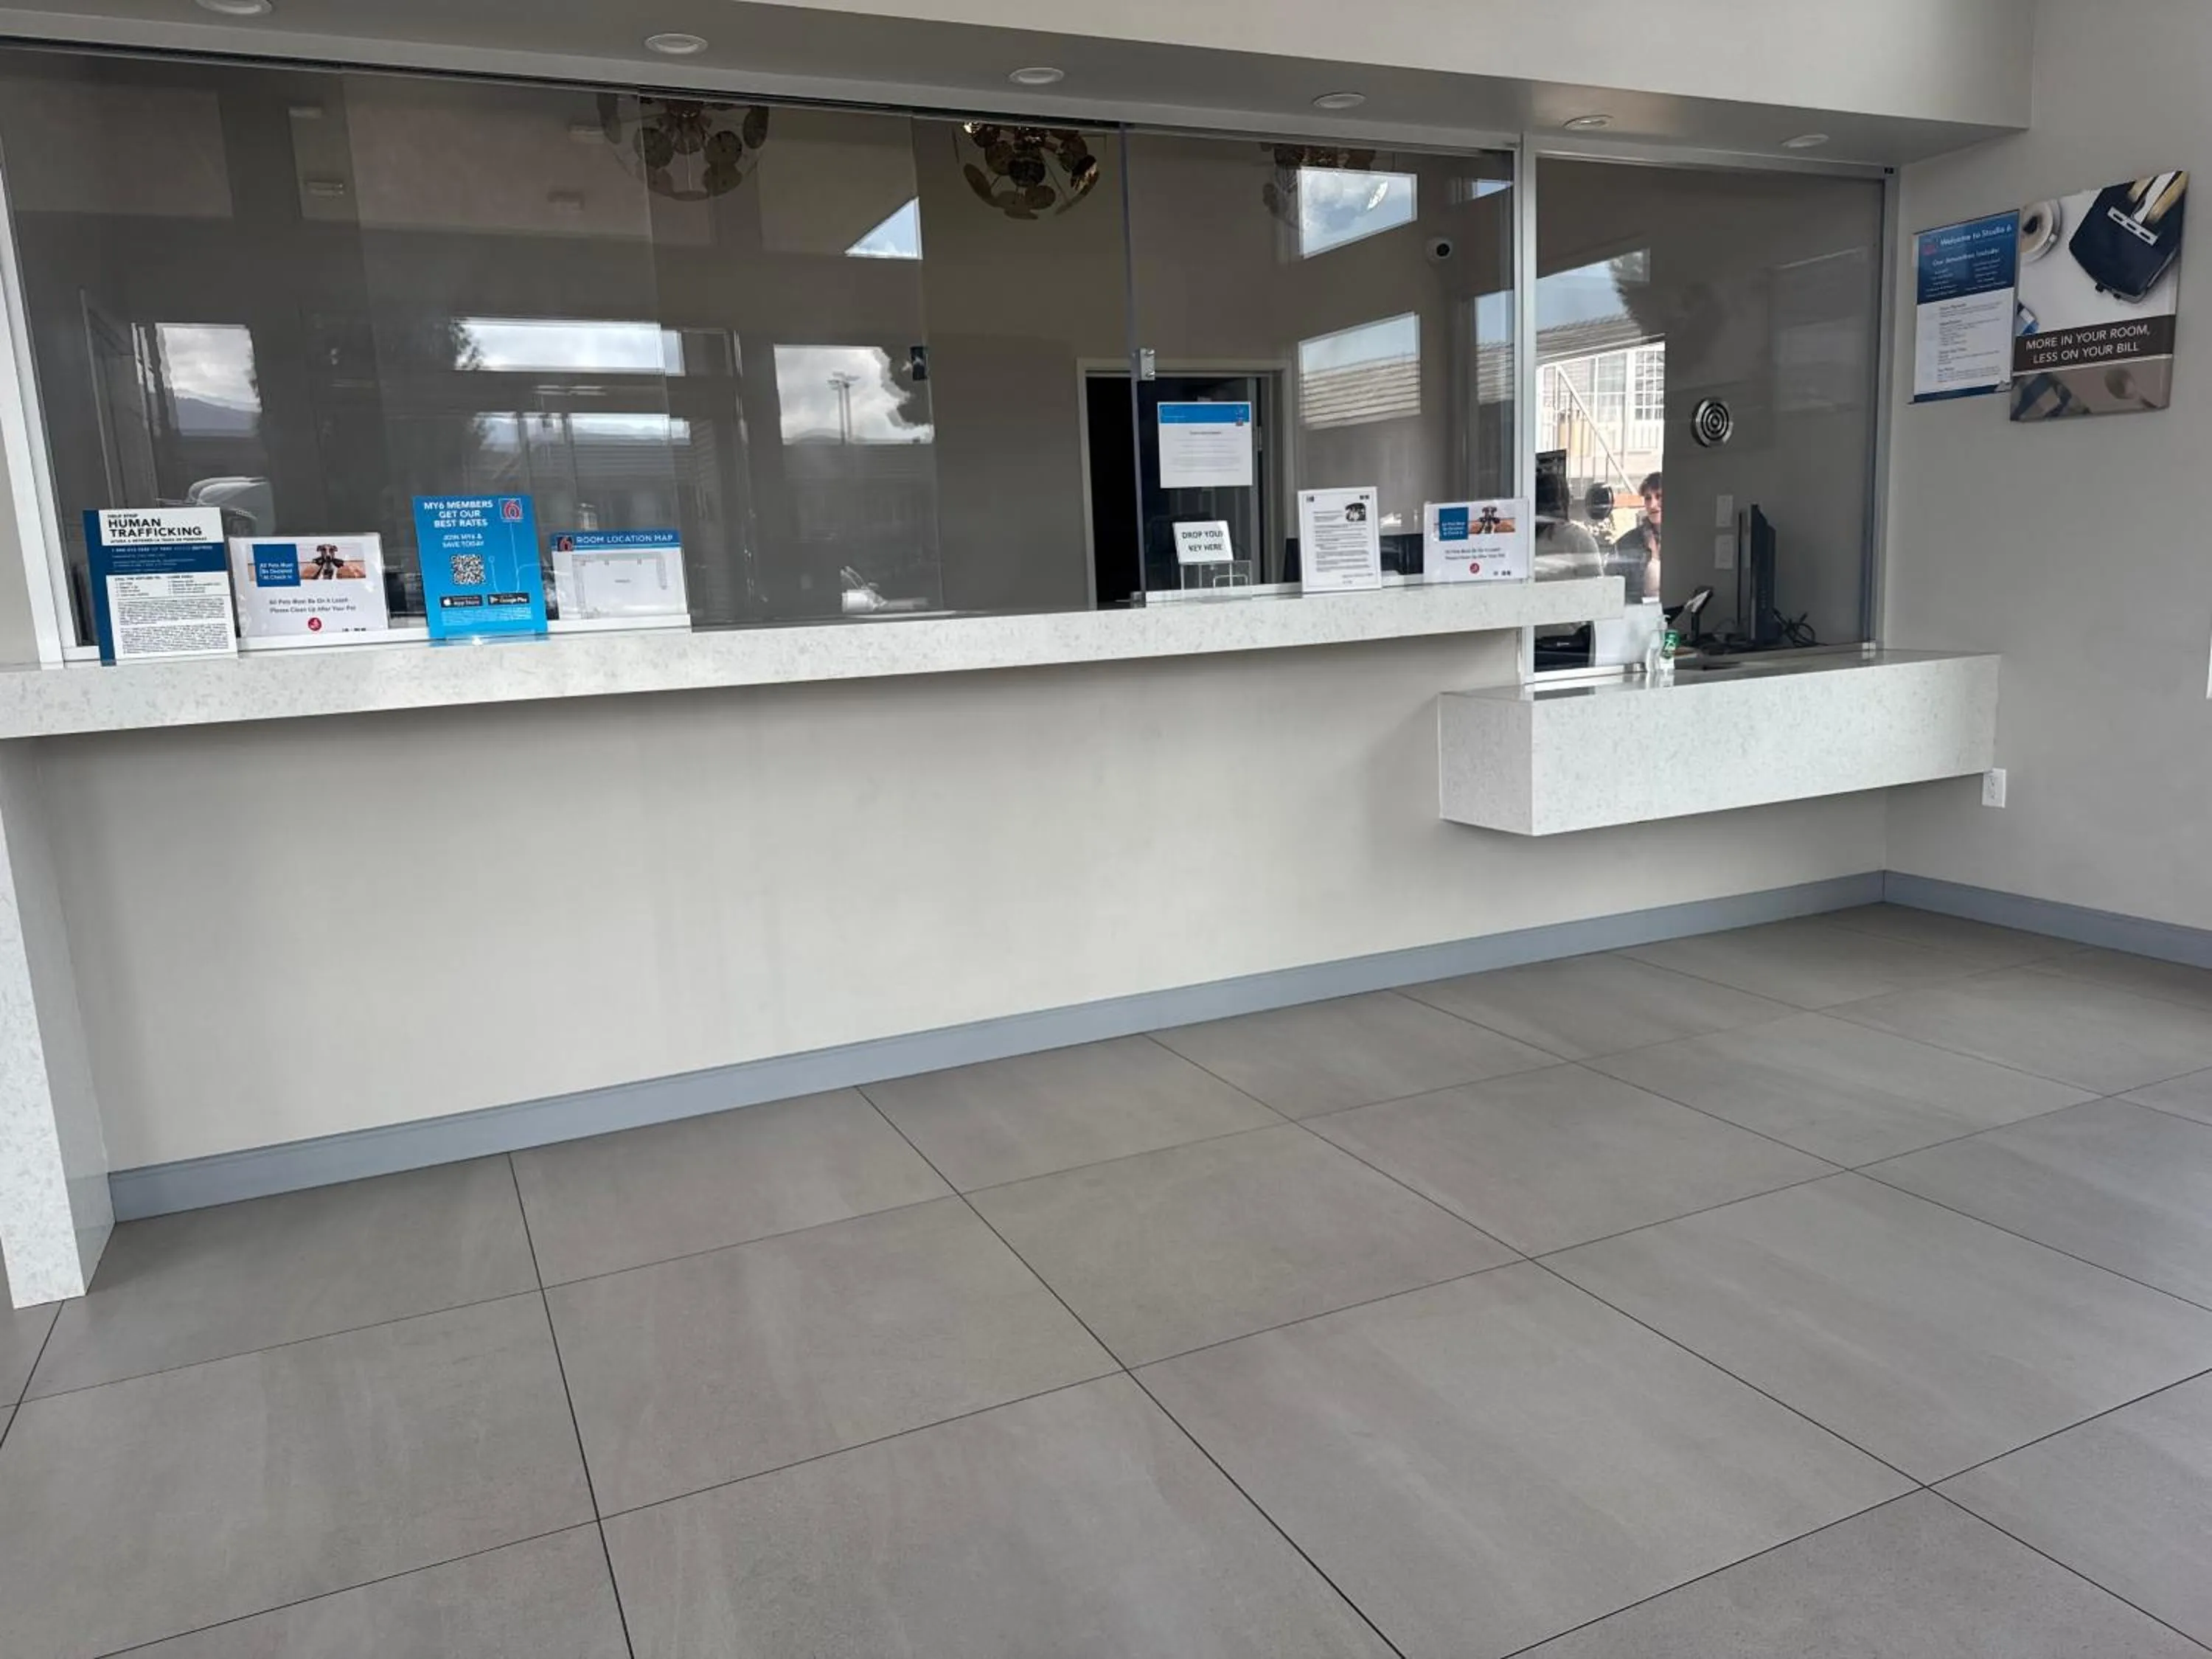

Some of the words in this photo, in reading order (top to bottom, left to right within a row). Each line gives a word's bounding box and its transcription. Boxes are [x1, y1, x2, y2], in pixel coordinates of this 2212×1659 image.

[1940, 235, 1971, 246] Welcome
[1981, 226, 2005, 237] Studio
[2025, 337, 2058, 350] MORE
[2061, 335, 2073, 346] IN
[2076, 330, 2107, 343] YOUR
[2033, 351, 2057, 364] LESS
[2061, 349, 2079, 361] ON
[2081, 344, 2112, 358] YOUR
[2116, 341, 2140, 353] BILL
[446, 499, 493, 509] MEMBERS
[439, 510, 457, 518] GET
[108, 518, 161, 529] HUMAN
[434, 519, 456, 529] BEST
[459, 518, 489, 527] RATES
[110, 526, 202, 538] TRAFFICKING
[1182, 531, 1203, 539] DROP
[576, 535, 604, 543] ROOM
[607, 535, 653, 543] LOCATION
